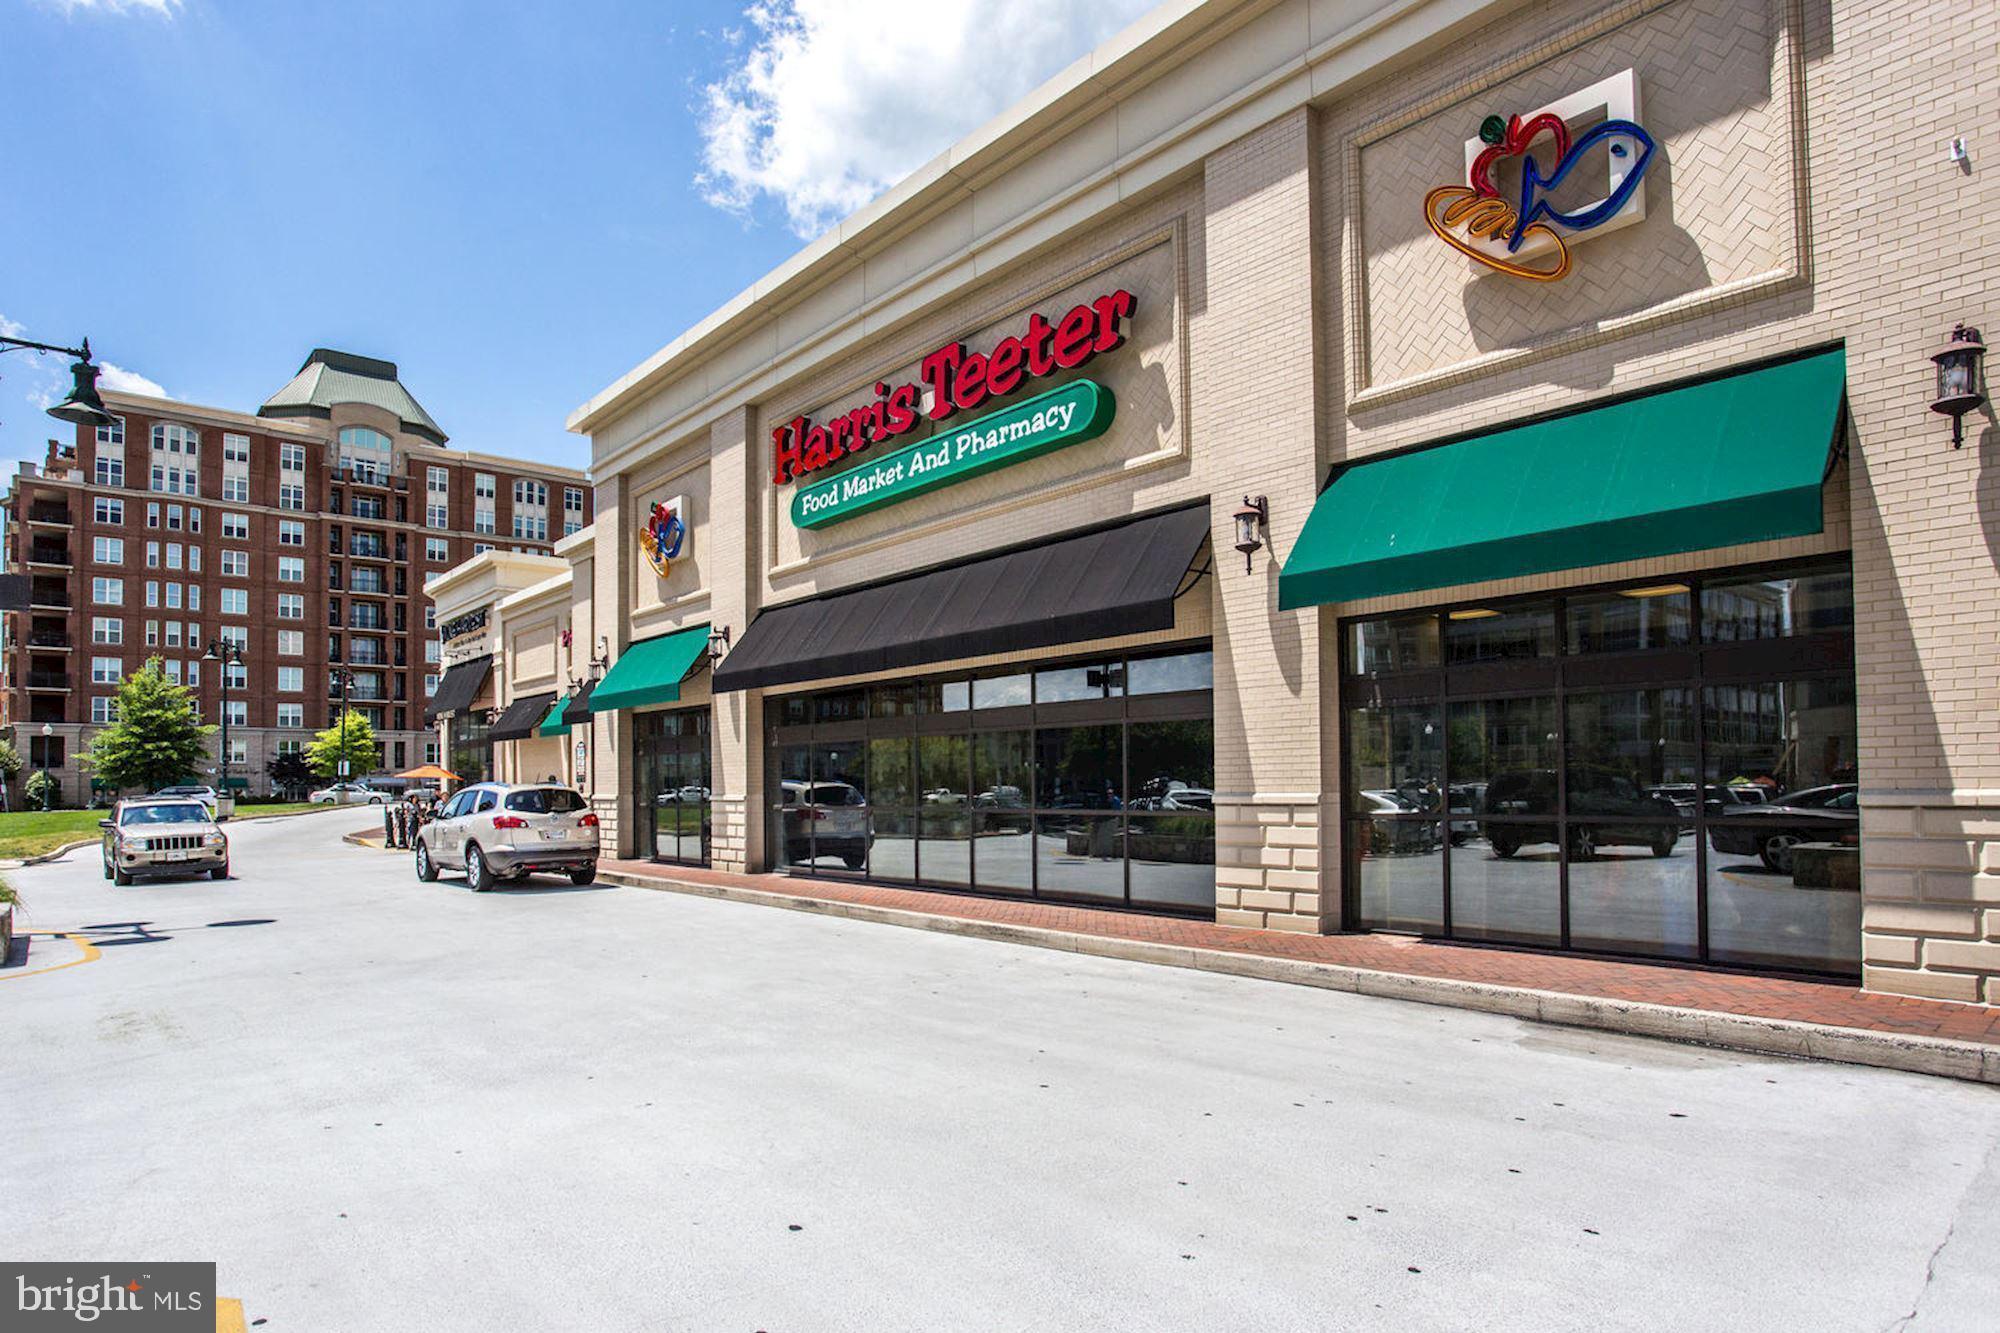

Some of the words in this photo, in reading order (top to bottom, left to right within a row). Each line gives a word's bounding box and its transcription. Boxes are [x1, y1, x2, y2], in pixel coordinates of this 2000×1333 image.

[773, 382, 921, 486] Harris
[921, 289, 1138, 421] Teeter
[801, 488, 839, 516] Food
[842, 464, 904, 502] Market
[908, 442, 950, 478] And
[956, 401, 1077, 461] Pharmacy
